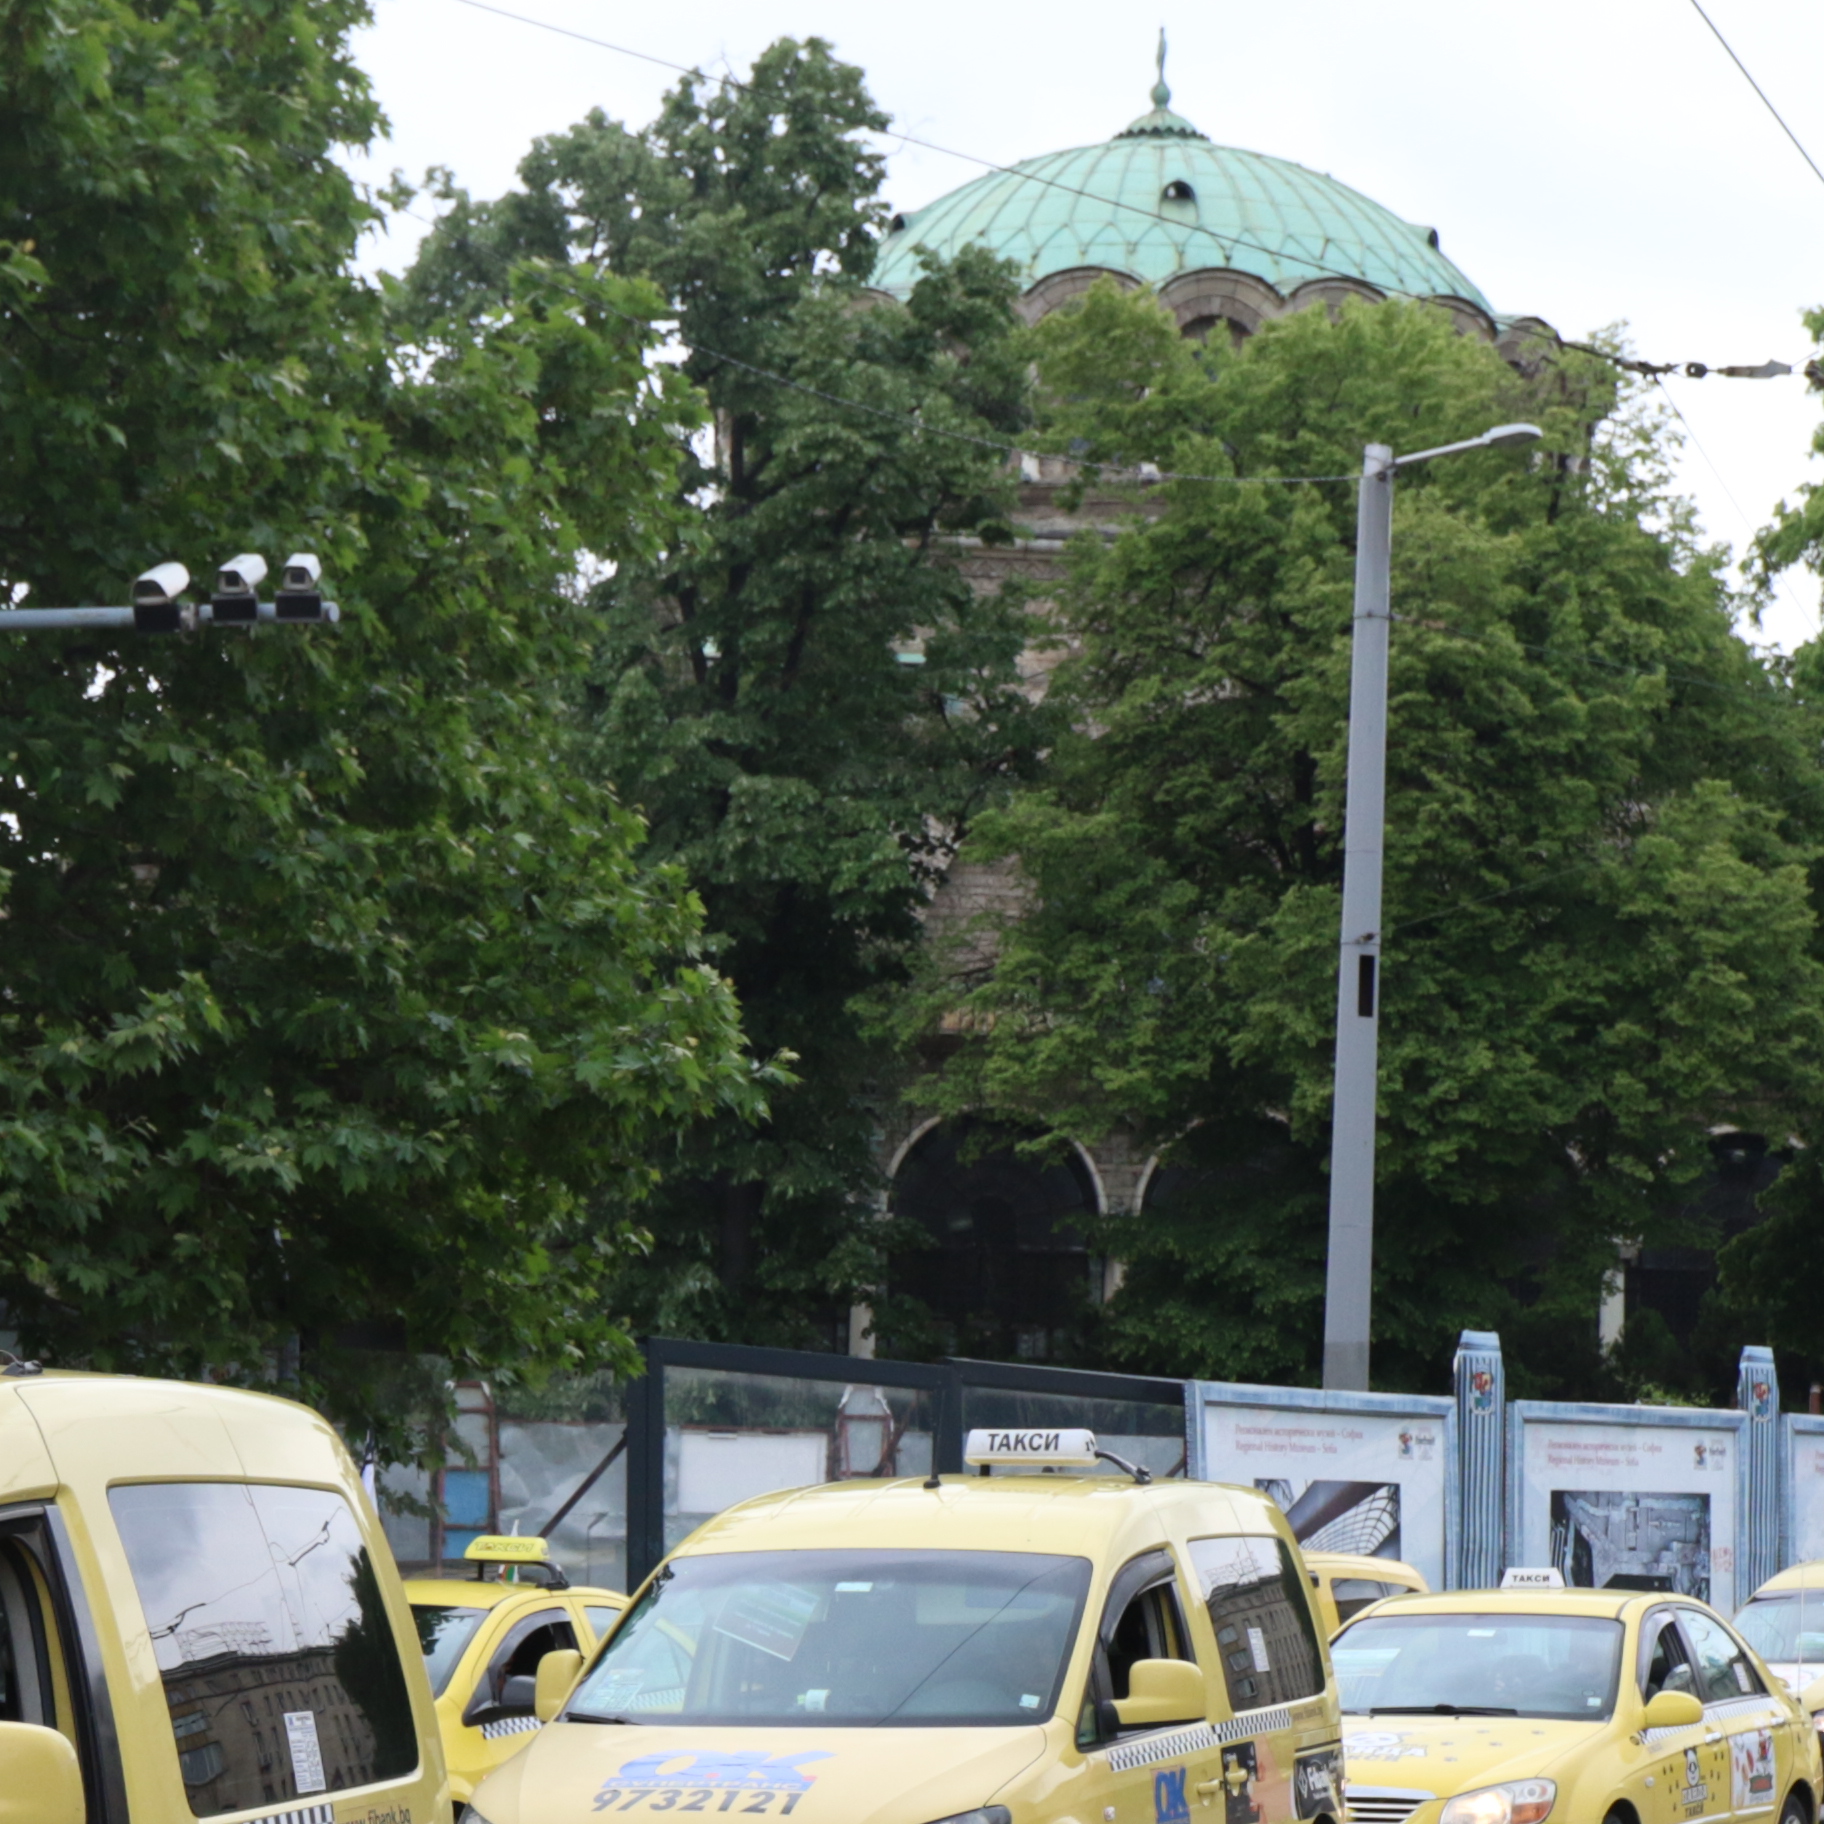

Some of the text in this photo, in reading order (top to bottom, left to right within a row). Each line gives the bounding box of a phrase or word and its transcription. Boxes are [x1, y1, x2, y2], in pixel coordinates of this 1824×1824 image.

[988, 1433, 1060, 1451] ТАКСИ
[1512, 1574, 1550, 1582] ТАКСИ
[591, 1789, 803, 1816] 9732121
